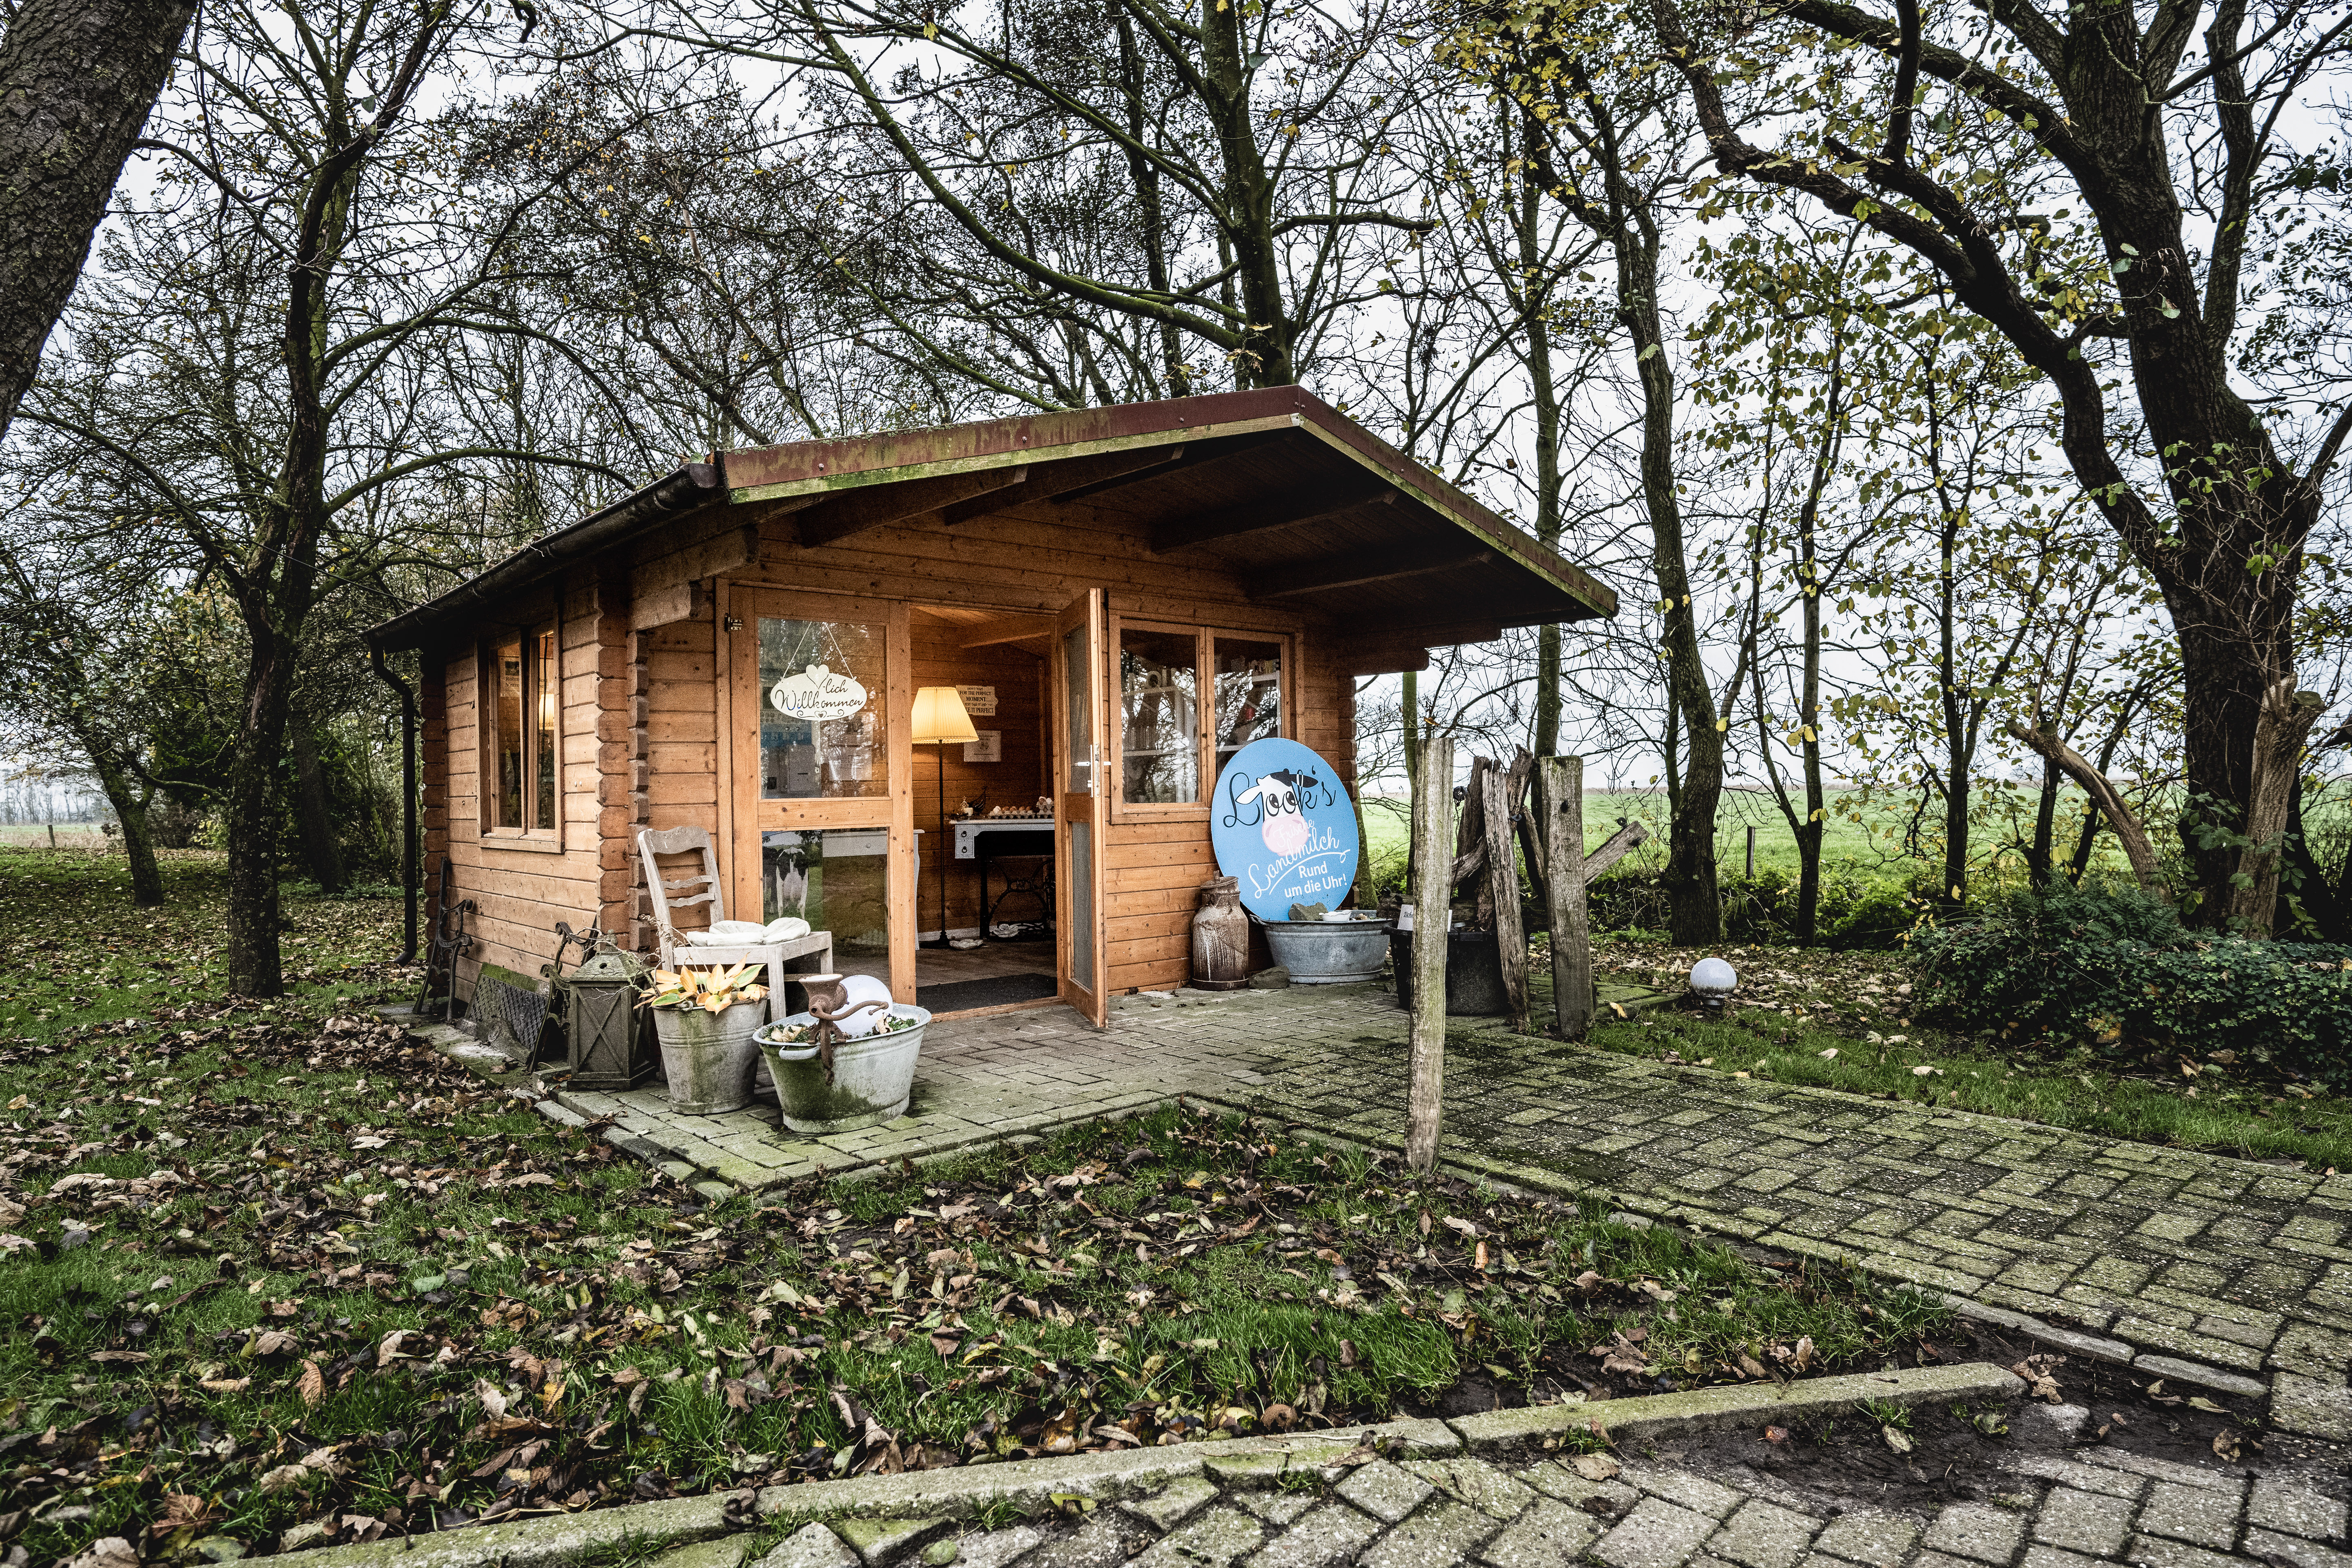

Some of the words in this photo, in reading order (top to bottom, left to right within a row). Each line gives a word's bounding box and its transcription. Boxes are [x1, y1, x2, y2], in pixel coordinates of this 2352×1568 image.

[775, 690, 863, 710] Willkommen
[1273, 816, 1314, 848] Frische
[1248, 826, 1339, 899] Landmilch
[1298, 861, 1327, 878] Rund
[1285, 886, 1302, 898] um
[1304, 880, 1321, 894] die
[1322, 873, 1347, 889] Uhr!
